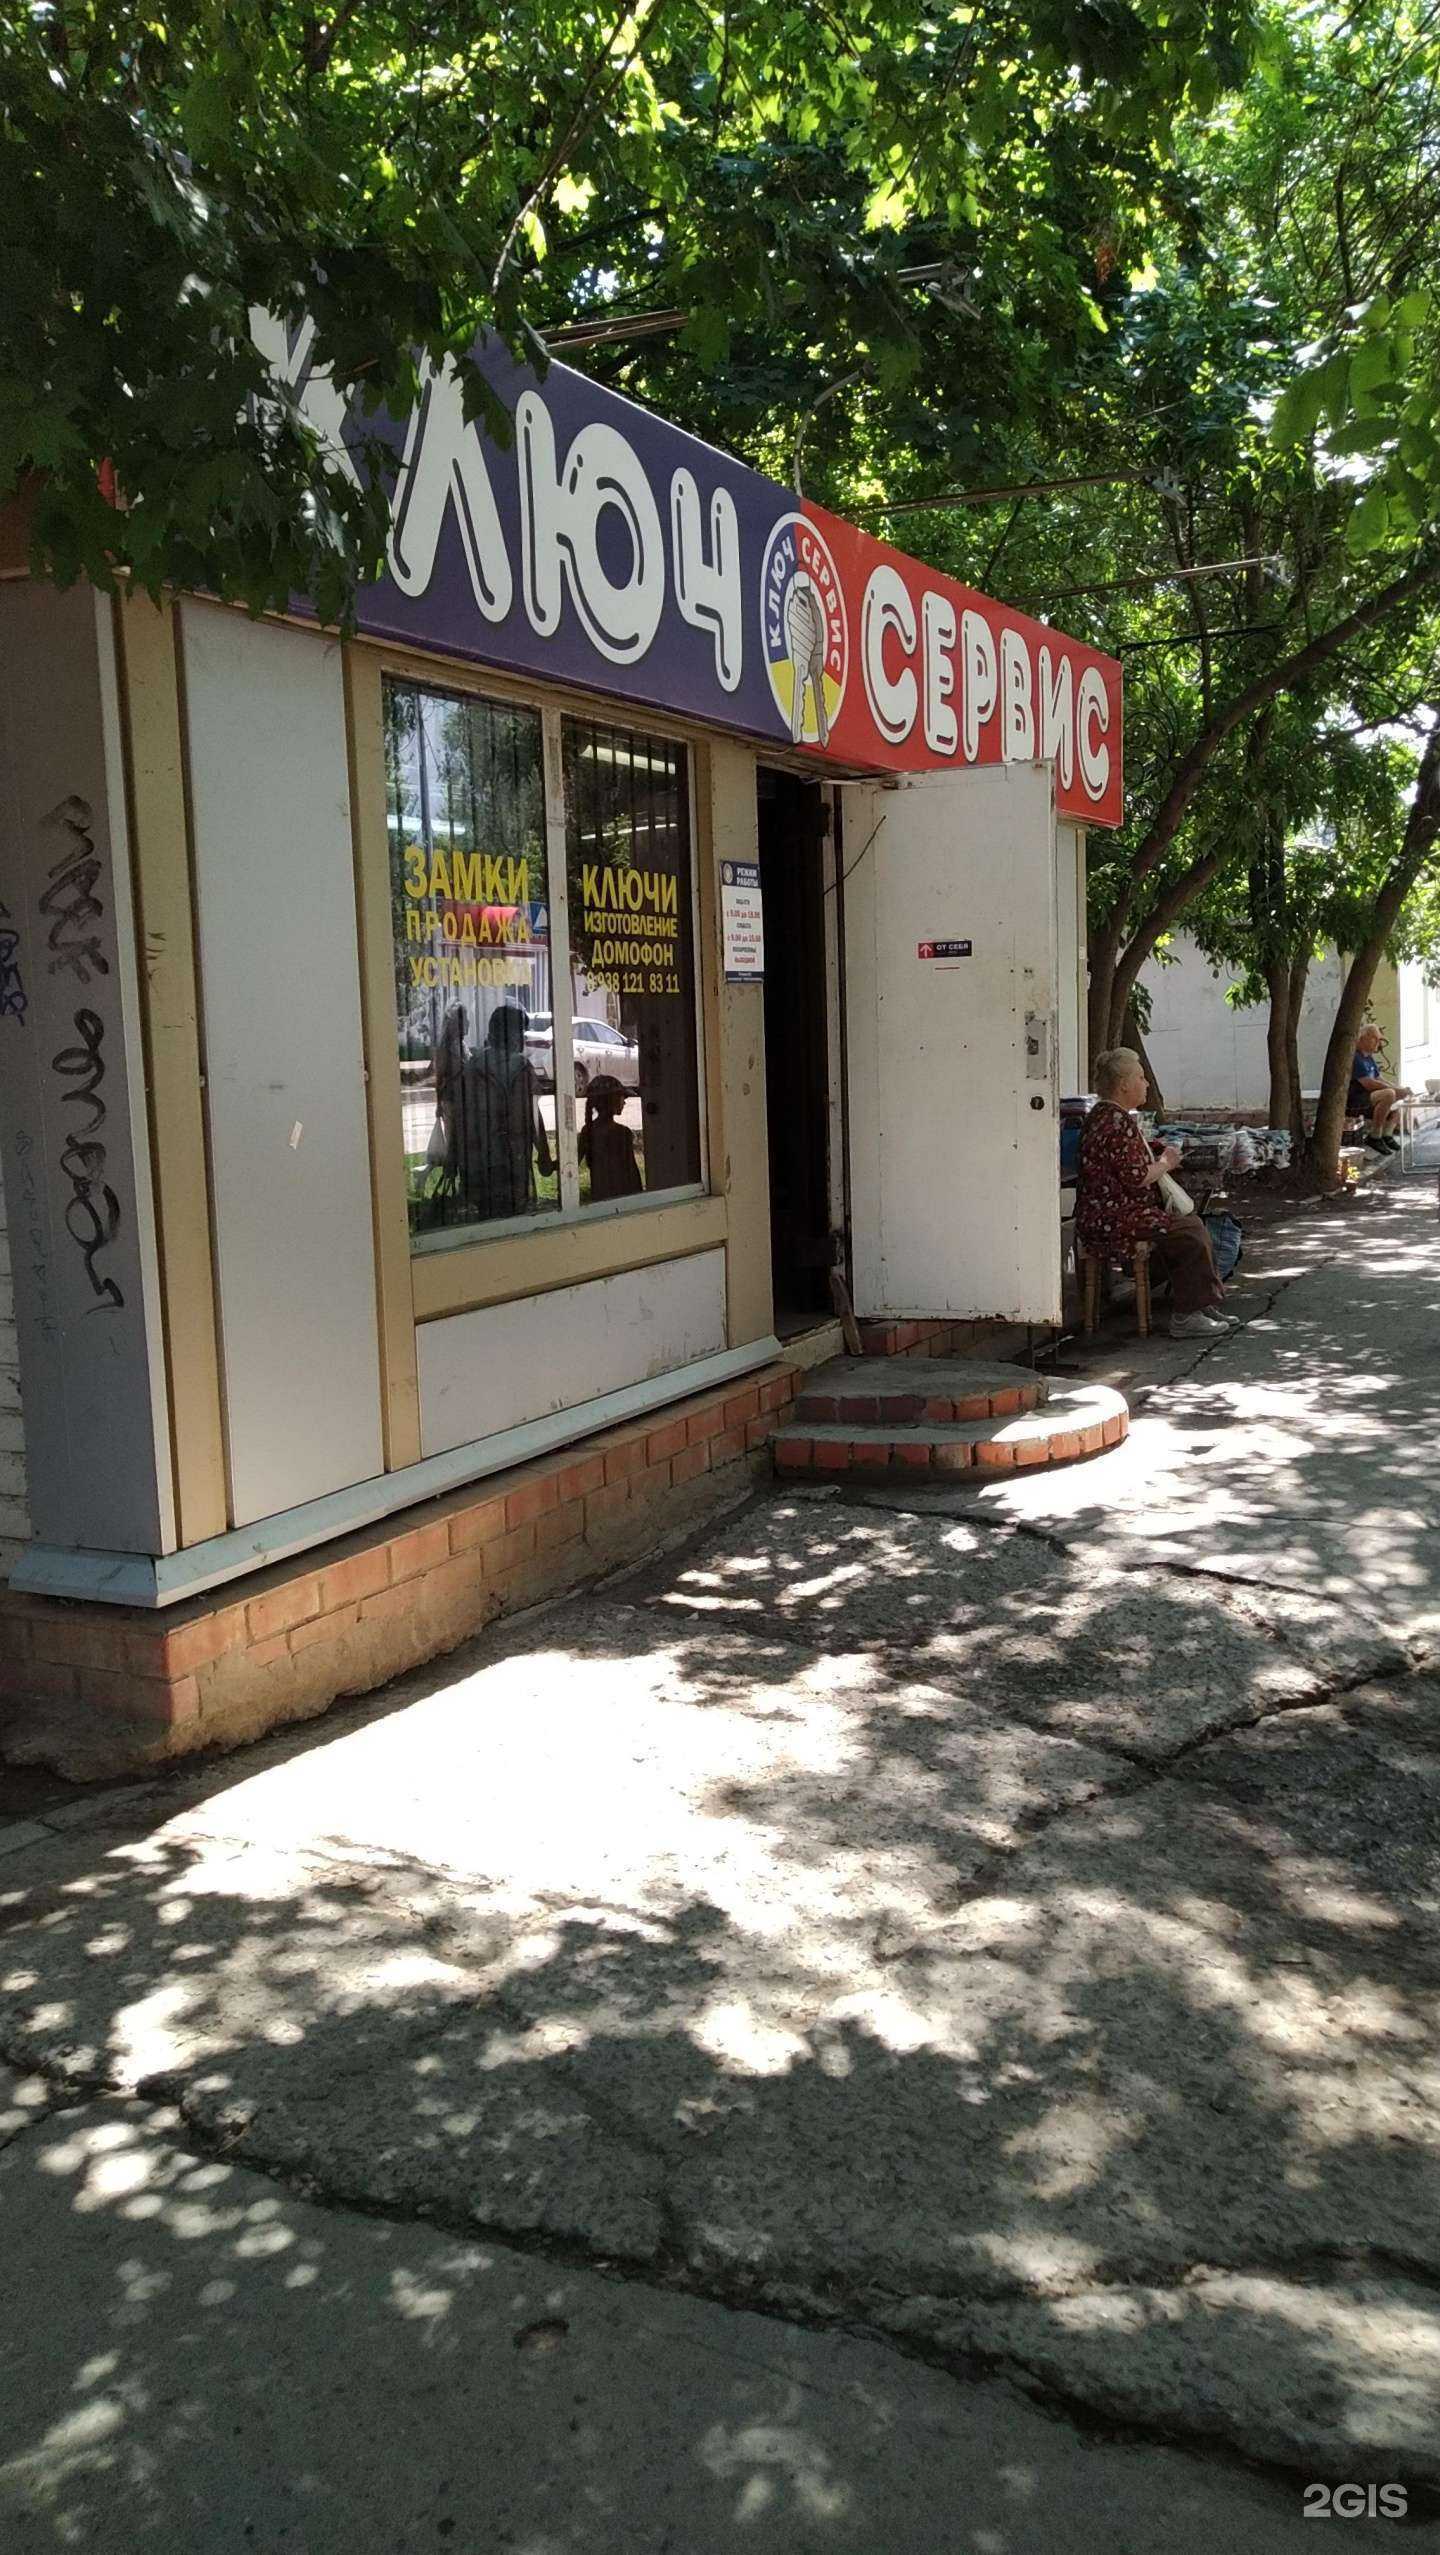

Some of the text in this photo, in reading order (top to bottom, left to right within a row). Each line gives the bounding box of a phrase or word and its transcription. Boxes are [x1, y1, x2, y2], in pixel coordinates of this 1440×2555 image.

[768, 534, 842, 673] КЛЮЧ СЕРВИС
[861, 564, 1110, 801] СЕРВИС
[404, 844, 530, 904] ЗАМКИ
[582, 863, 679, 915] КЛЮЧИ
[736, 877, 758, 888] РАБОТЫ
[406, 910, 532, 947] ПРОДАЖА
[584, 912, 679, 938] ИЗГОТОВЛЕНИЕ
[591, 939, 674, 969] ДОМОФОН
[623, 972, 645, 993] 121
[649, 973, 664, 993] 83
[665, 974, 681, 993] 11
